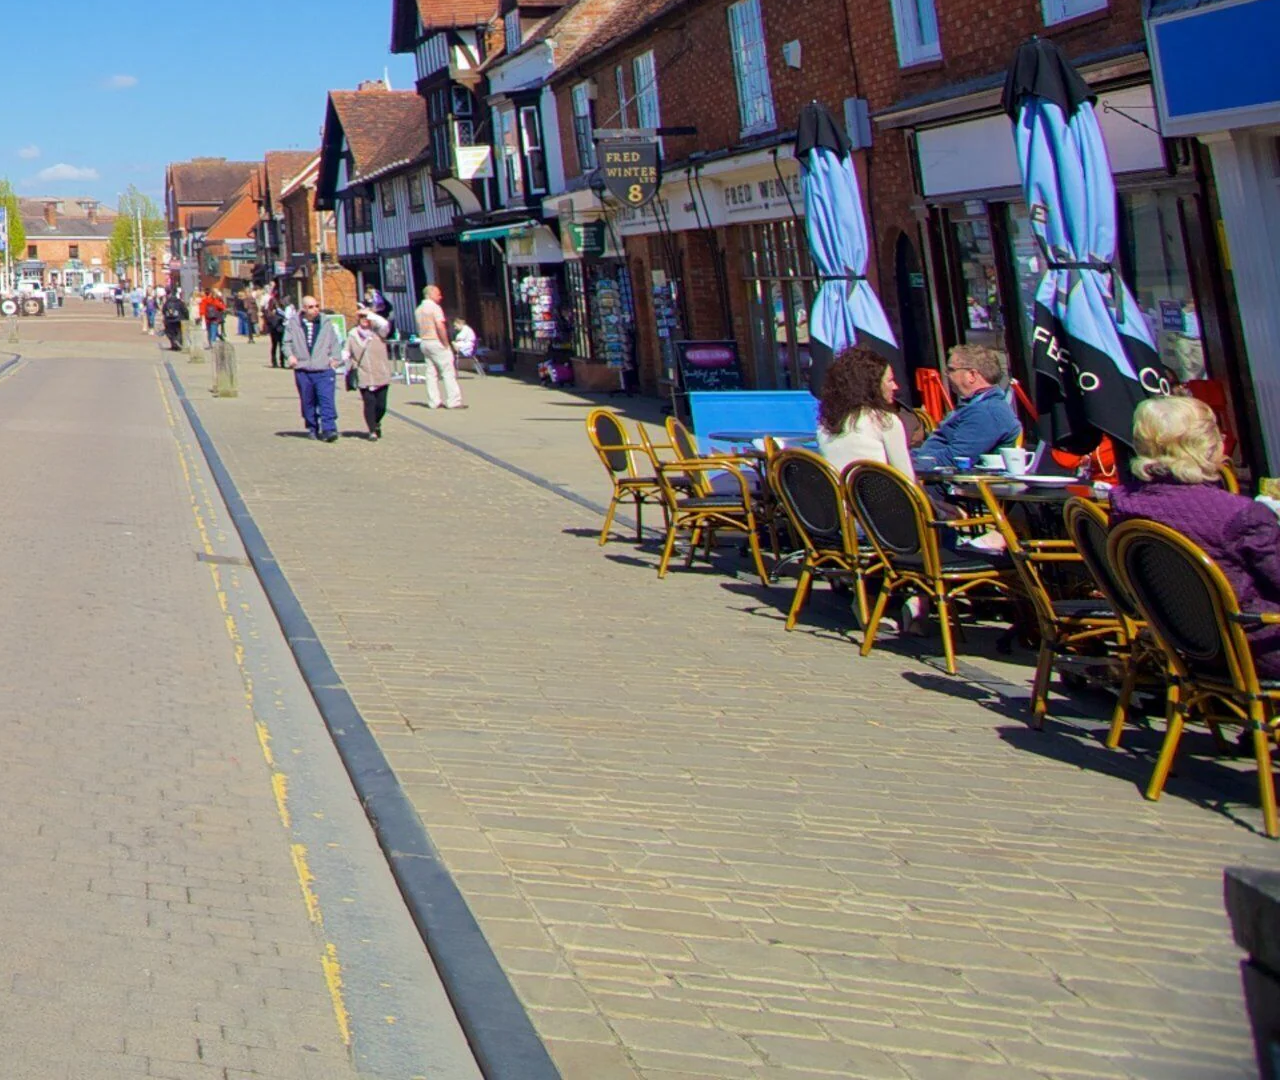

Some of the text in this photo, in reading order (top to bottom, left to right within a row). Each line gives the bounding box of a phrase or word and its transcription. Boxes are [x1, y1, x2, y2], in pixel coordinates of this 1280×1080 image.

[606, 152, 641, 163] FRED
[606, 166, 657, 177] WINTER
[628, 184, 643, 202] 8
[724, 174, 801, 206] FRED WINTE
